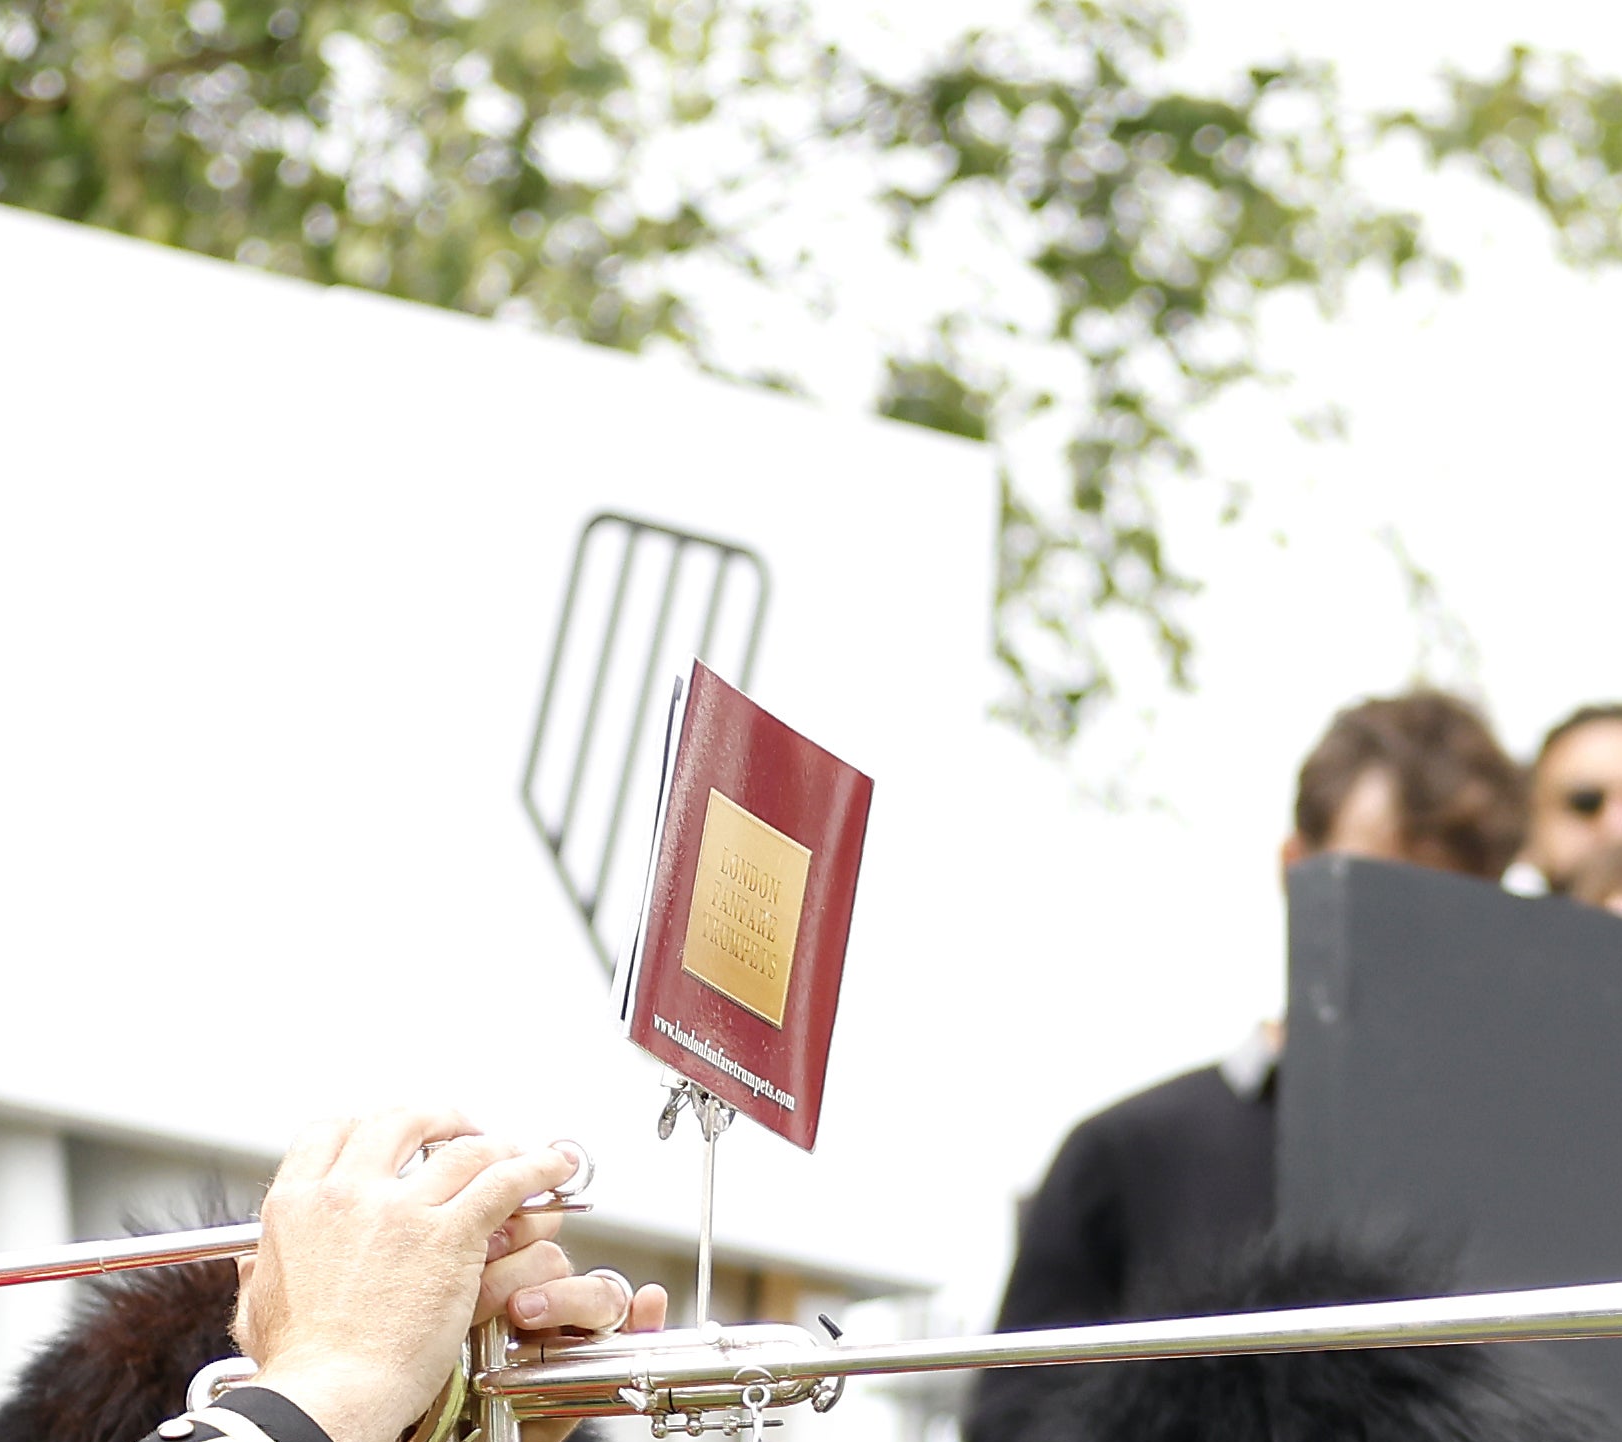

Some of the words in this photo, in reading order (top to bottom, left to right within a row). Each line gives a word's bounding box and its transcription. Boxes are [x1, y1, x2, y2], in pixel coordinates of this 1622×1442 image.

[720, 846, 781, 905] LONDON
[711, 880, 777, 943] FANFARE
[702, 911, 778, 980] TRUMPETS
[653, 1013, 795, 1112] www.londonfanfaretrumpets.com
